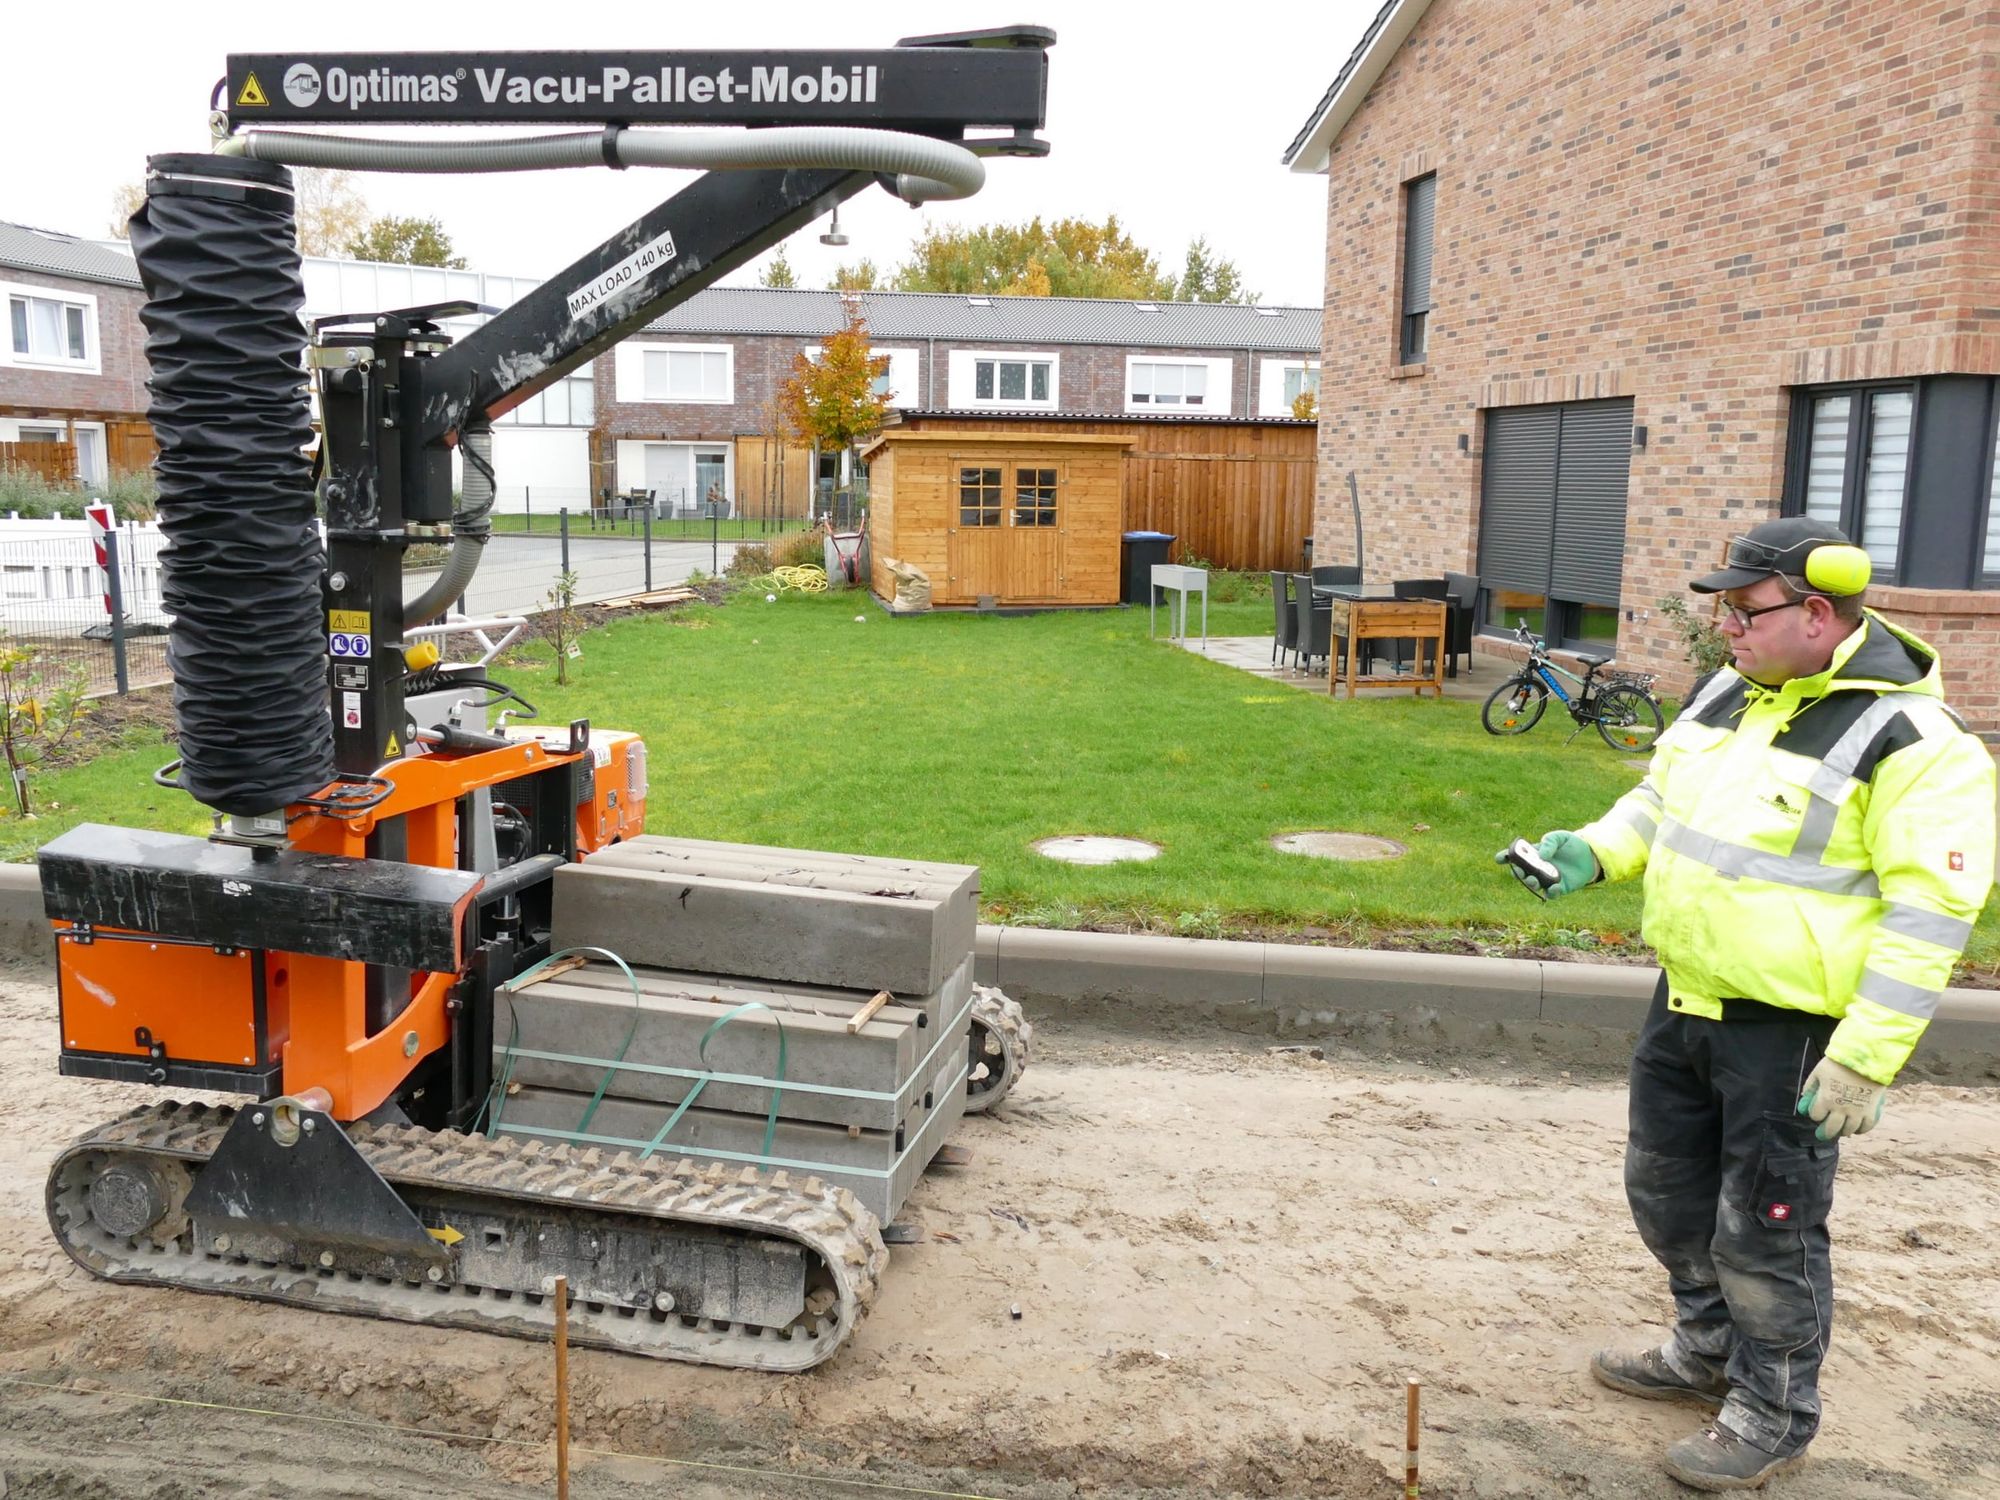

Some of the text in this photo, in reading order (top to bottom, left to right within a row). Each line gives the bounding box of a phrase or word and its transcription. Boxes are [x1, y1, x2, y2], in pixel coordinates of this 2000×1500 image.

[474, 65, 878, 104] Vacu-Pallet-Mobil
[570, 241, 674, 315] MAX LOAD 140 kg
